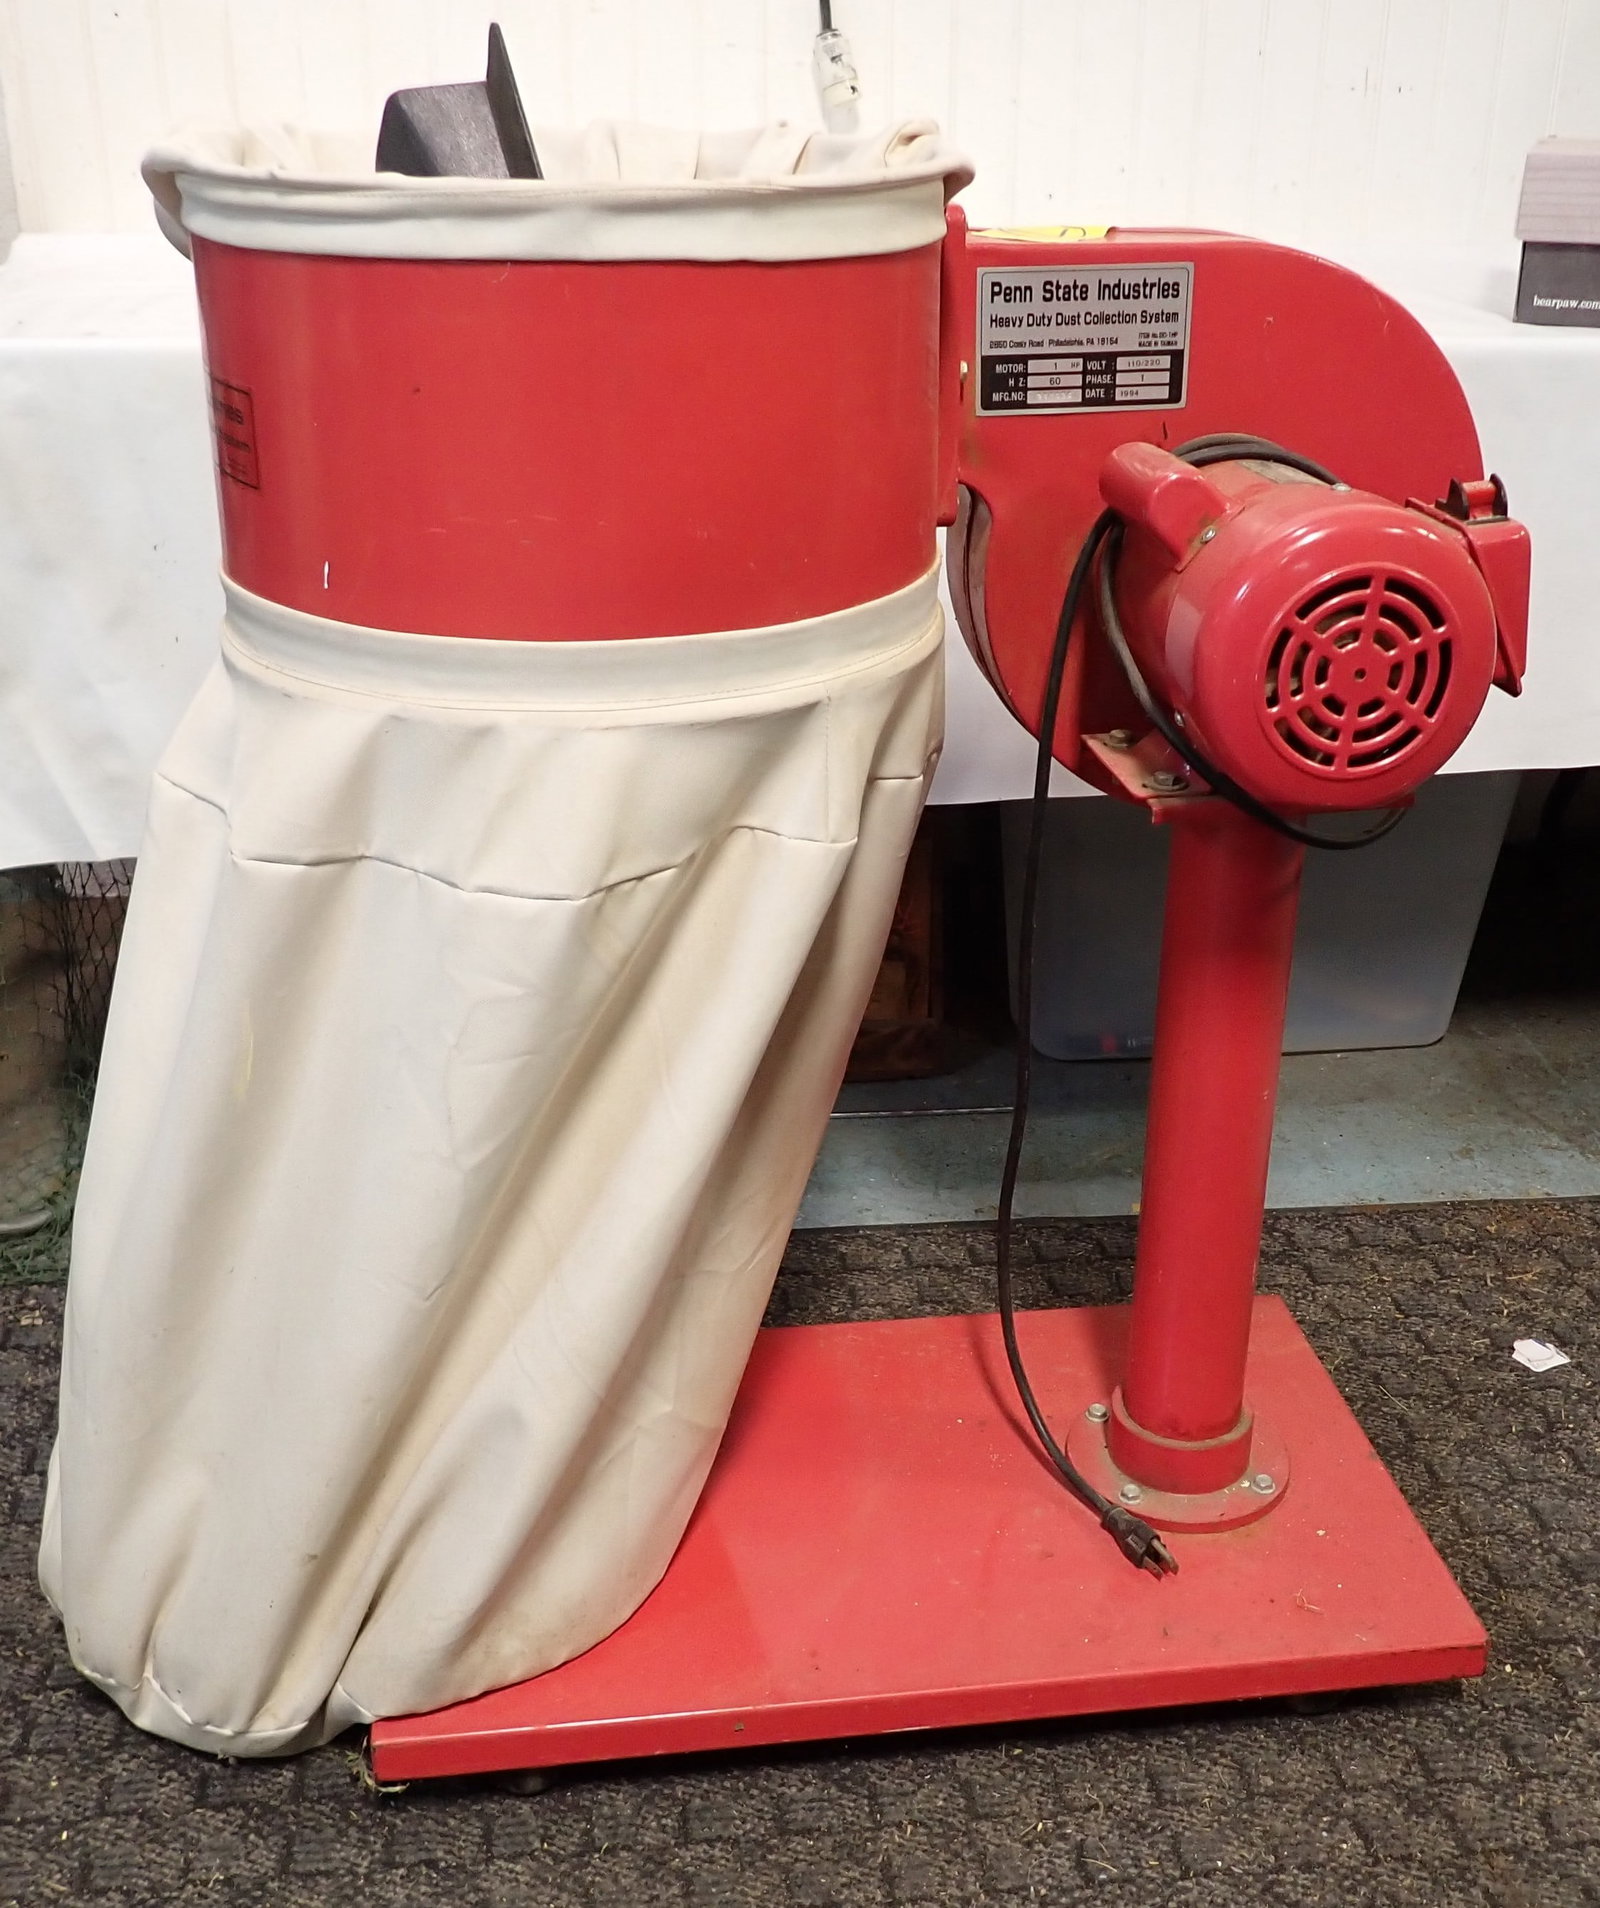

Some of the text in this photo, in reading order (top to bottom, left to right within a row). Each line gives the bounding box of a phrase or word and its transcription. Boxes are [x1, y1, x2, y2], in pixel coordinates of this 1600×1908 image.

[990, 277, 1181, 304] Penn State Industries
[989, 309, 1179, 329] Heavy Duty Dust Collection System
[1028, 339, 1045, 348] Road
[1086, 337, 1095, 346] PA
[995, 363, 1027, 374] MOTOR:
[1127, 358, 1161, 368] 110/220
[1049, 376, 1061, 386] 60
[1086, 375, 1114, 385] PHASE:
[992, 391, 1026, 402] MFG.NO:
[1120, 389, 1139, 397] 1994
